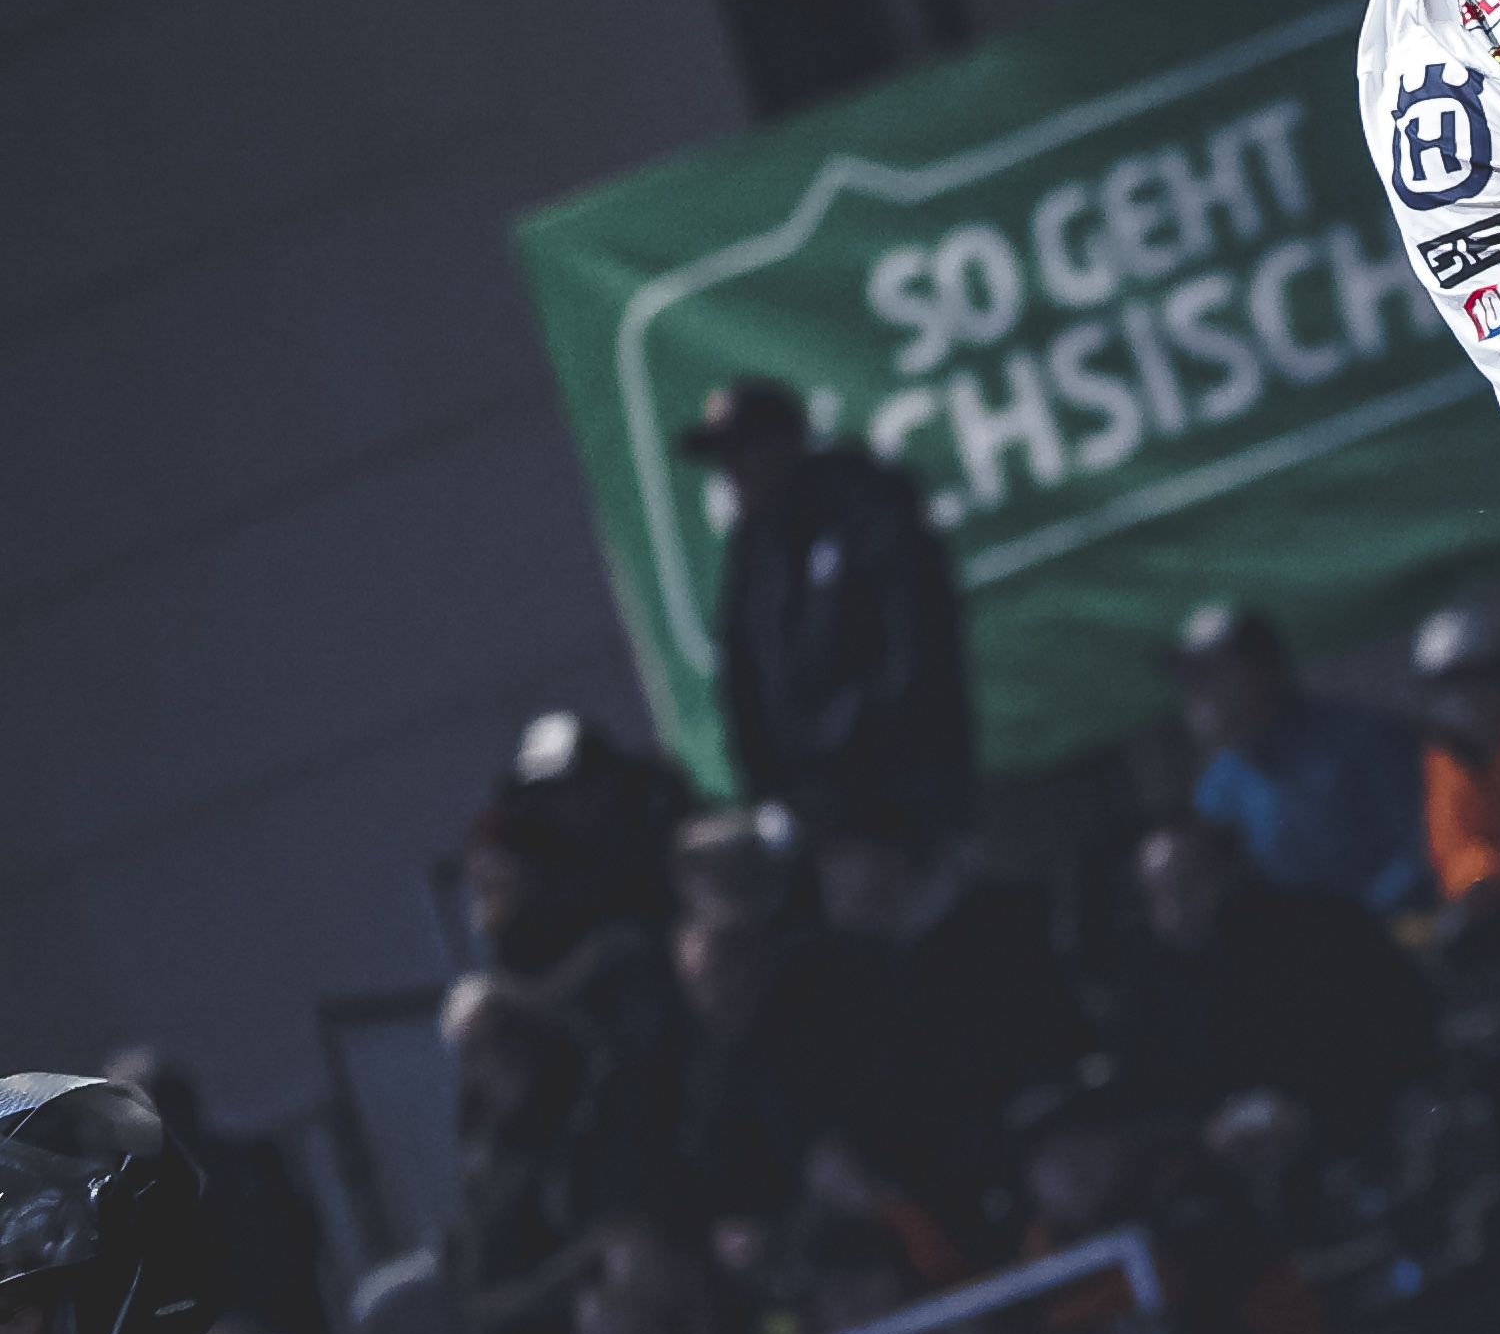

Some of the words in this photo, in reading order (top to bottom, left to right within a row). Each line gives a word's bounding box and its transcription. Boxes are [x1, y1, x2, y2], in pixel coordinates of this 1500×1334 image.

[867, 222, 1027, 374] SO
[1029, 97, 1309, 308] GEHT
[867, 222, 1442, 529] CHSISCH
